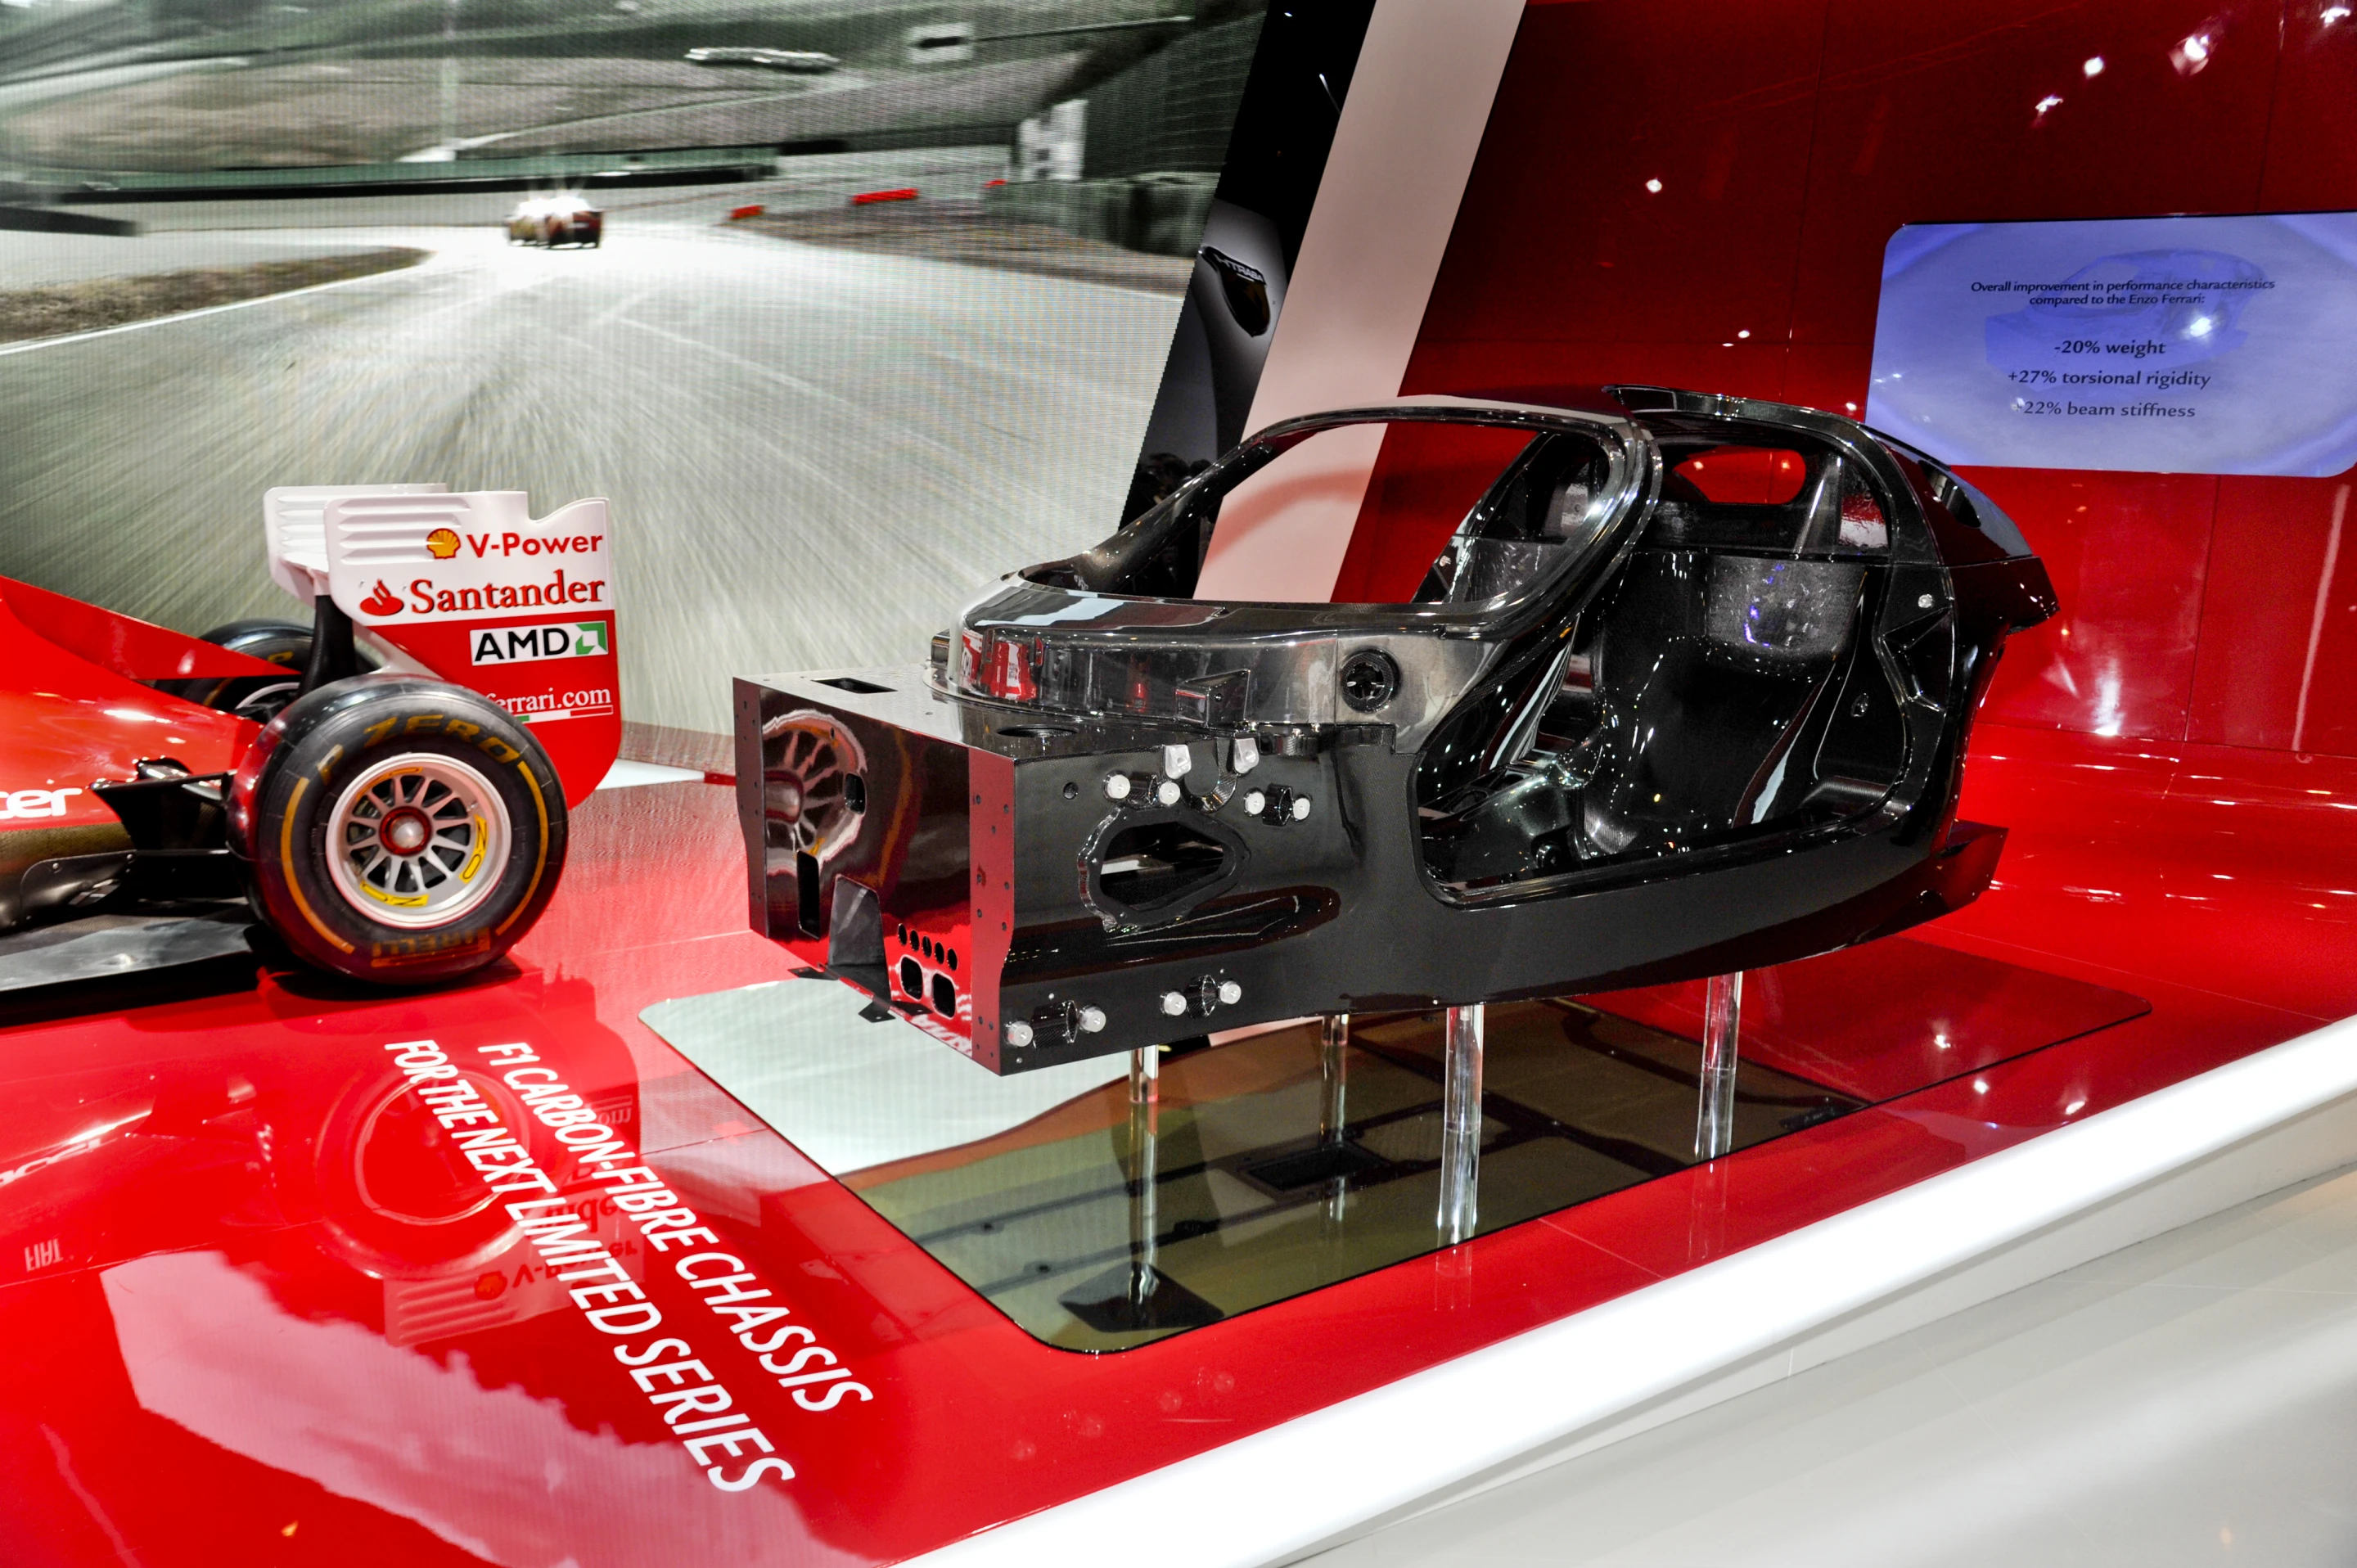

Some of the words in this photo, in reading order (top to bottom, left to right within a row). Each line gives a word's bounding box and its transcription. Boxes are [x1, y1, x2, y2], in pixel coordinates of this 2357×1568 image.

[1971, 281, 2011, 292] Overall
[2013, 281, 2091, 294] improvement
[2093, 280, 2104, 291] in
[2106, 279, 2184, 293] performance
[2186, 278, 2276, 291] characteristics
[2030, 294, 2089, 307] compared
[2091, 295, 2104, 304] to
[2107, 294, 2126, 304] the
[2129, 295, 2159, 304] Enzo
[2161, 293, 2206, 304] Ferrari:
[2054, 340, 2101, 354] -20%
[2106, 340, 2167, 358] weight
[2008, 370, 2057, 385] +27%
[2062, 370, 2142, 385] torsional
[2146, 371, 2211, 390] rigidity
[2067, 401, 2116, 416] beam
[2120, 402, 2196, 417] stiffness
[466, 532, 604, 559] V-Power
[410, 569, 606, 615] Santander
[474, 628, 570, 662] AMD
[317, 743, 345, 786] P
[363, 714, 521, 764] ZERO
[384, 1039, 459, 1084] FOR
[477, 1042, 541, 1066] F1
[417, 1079, 500, 1129] THE
[451, 1127, 558, 1194] NEXT
[502, 1067, 719, 1253] CARBON-FIBRE
[504, 1196, 662, 1335] LIMITED
[674, 1251, 874, 1413] CHASSIS
[613, 1337, 796, 1493] SERIES
